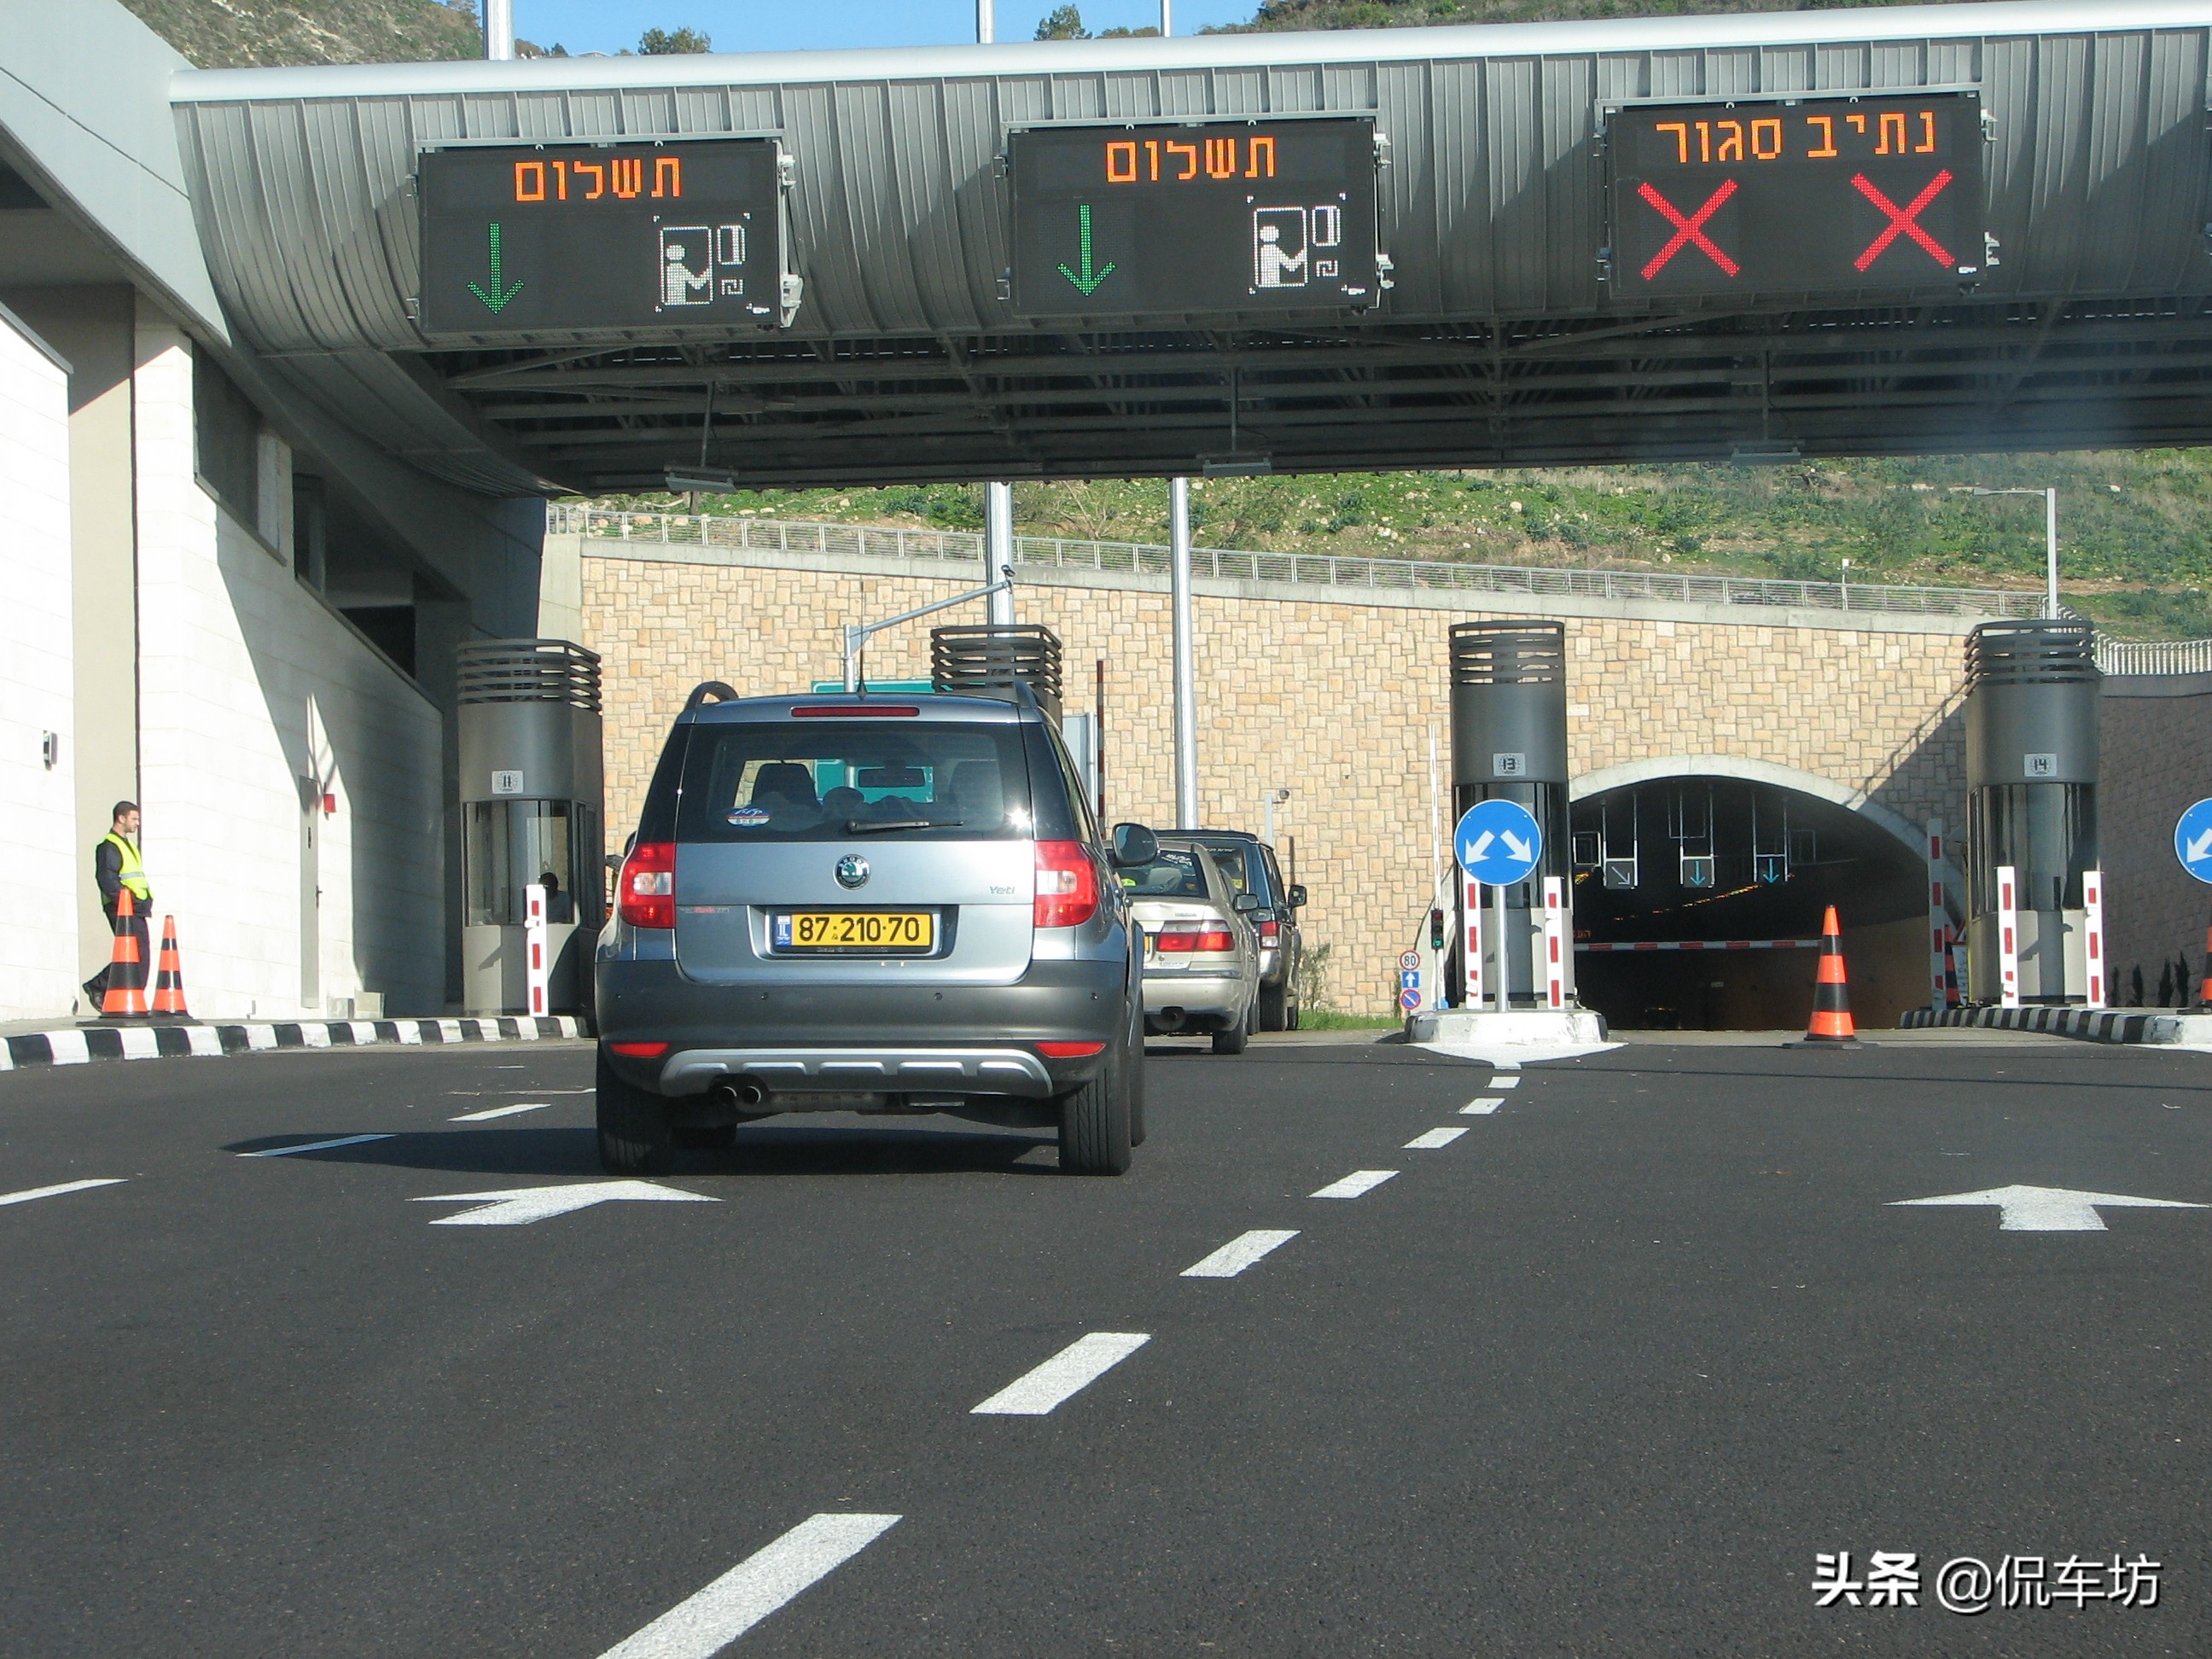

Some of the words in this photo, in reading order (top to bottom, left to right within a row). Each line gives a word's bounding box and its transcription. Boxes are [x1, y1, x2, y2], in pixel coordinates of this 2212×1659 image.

[1656, 118, 1782, 163] סגור
[1807, 111, 1935, 158] נתיב
[1106, 137, 1274, 183] תשלום
[515, 157, 680, 201] תשלום
[1503, 758, 1516, 771] 13
[2034, 759, 2047, 771] 14
[989, 886, 1016, 894] Yeti
[1404, 955, 1417, 966] 80
